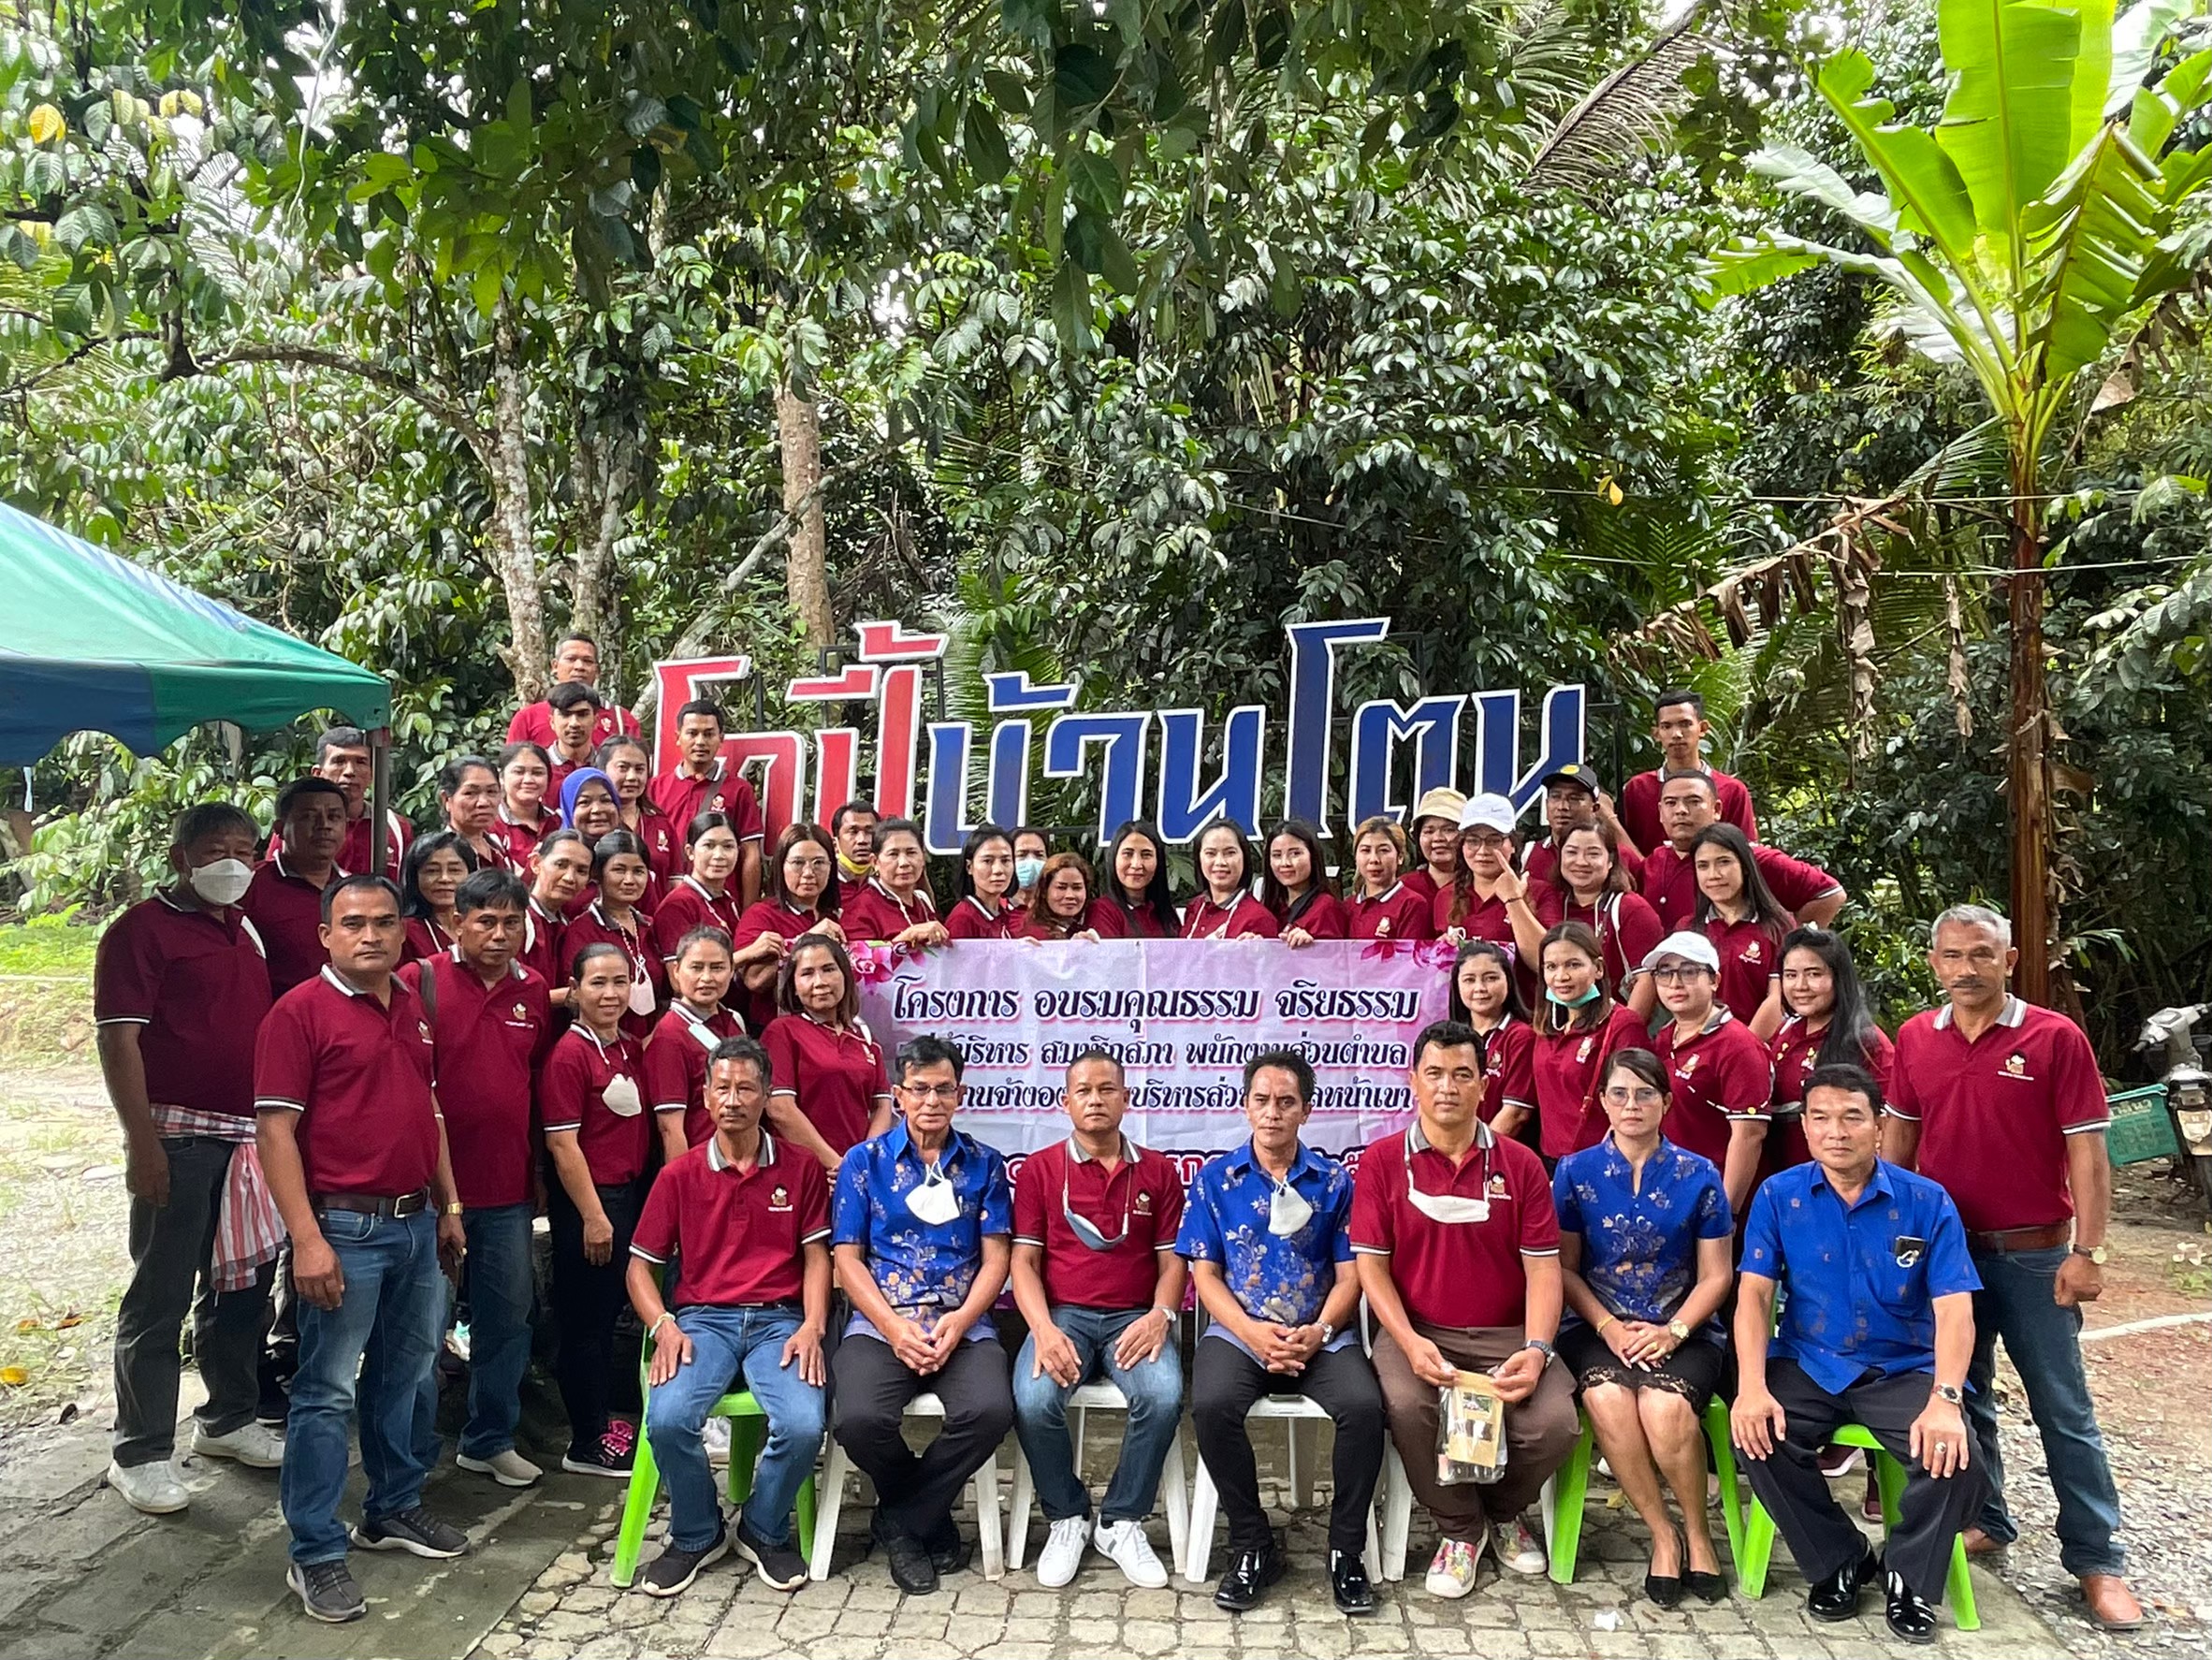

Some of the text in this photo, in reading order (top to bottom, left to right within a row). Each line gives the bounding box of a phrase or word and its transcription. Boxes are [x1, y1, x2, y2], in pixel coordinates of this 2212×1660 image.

[893, 974, 1419, 1034] โครงการ อบรมคุณธรรม จริยธรรม
